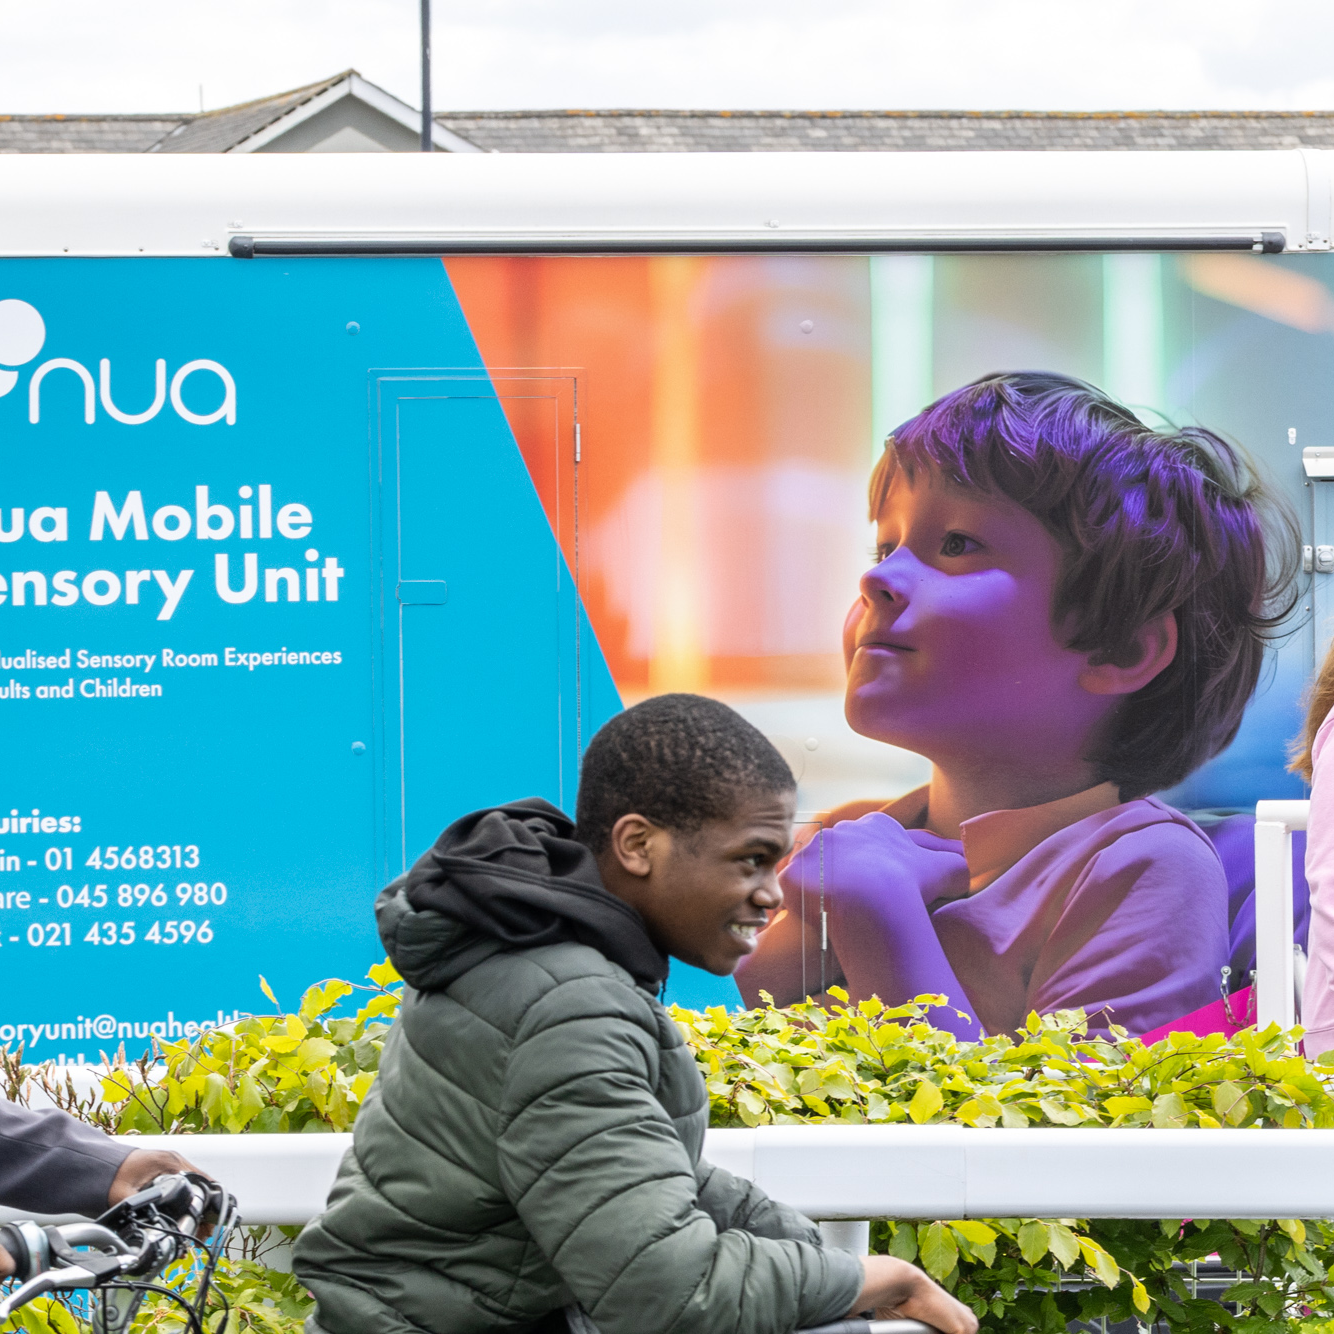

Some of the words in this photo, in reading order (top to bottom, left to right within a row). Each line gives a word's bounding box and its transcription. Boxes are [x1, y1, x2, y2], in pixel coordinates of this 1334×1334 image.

[29, 358, 236, 426] nua
[89, 484, 313, 541] Mobile
[215, 548, 344, 604] Unit
[76, 648, 156, 673] Sensory
[162, 648, 218, 667] Room
[224, 647, 342, 670] Experiences
[35, 679, 74, 698] and
[80, 678, 162, 698] Children
[45, 847, 73, 871] 01
[85, 845, 199, 870] 4568313
[56, 884, 108, 908] 045
[117, 883, 168, 907] 896
[175, 882, 227, 906] 980
[27, 922, 71, 946] 021
[84, 922, 135, 945] 435
[144, 920, 213, 944] 4596
